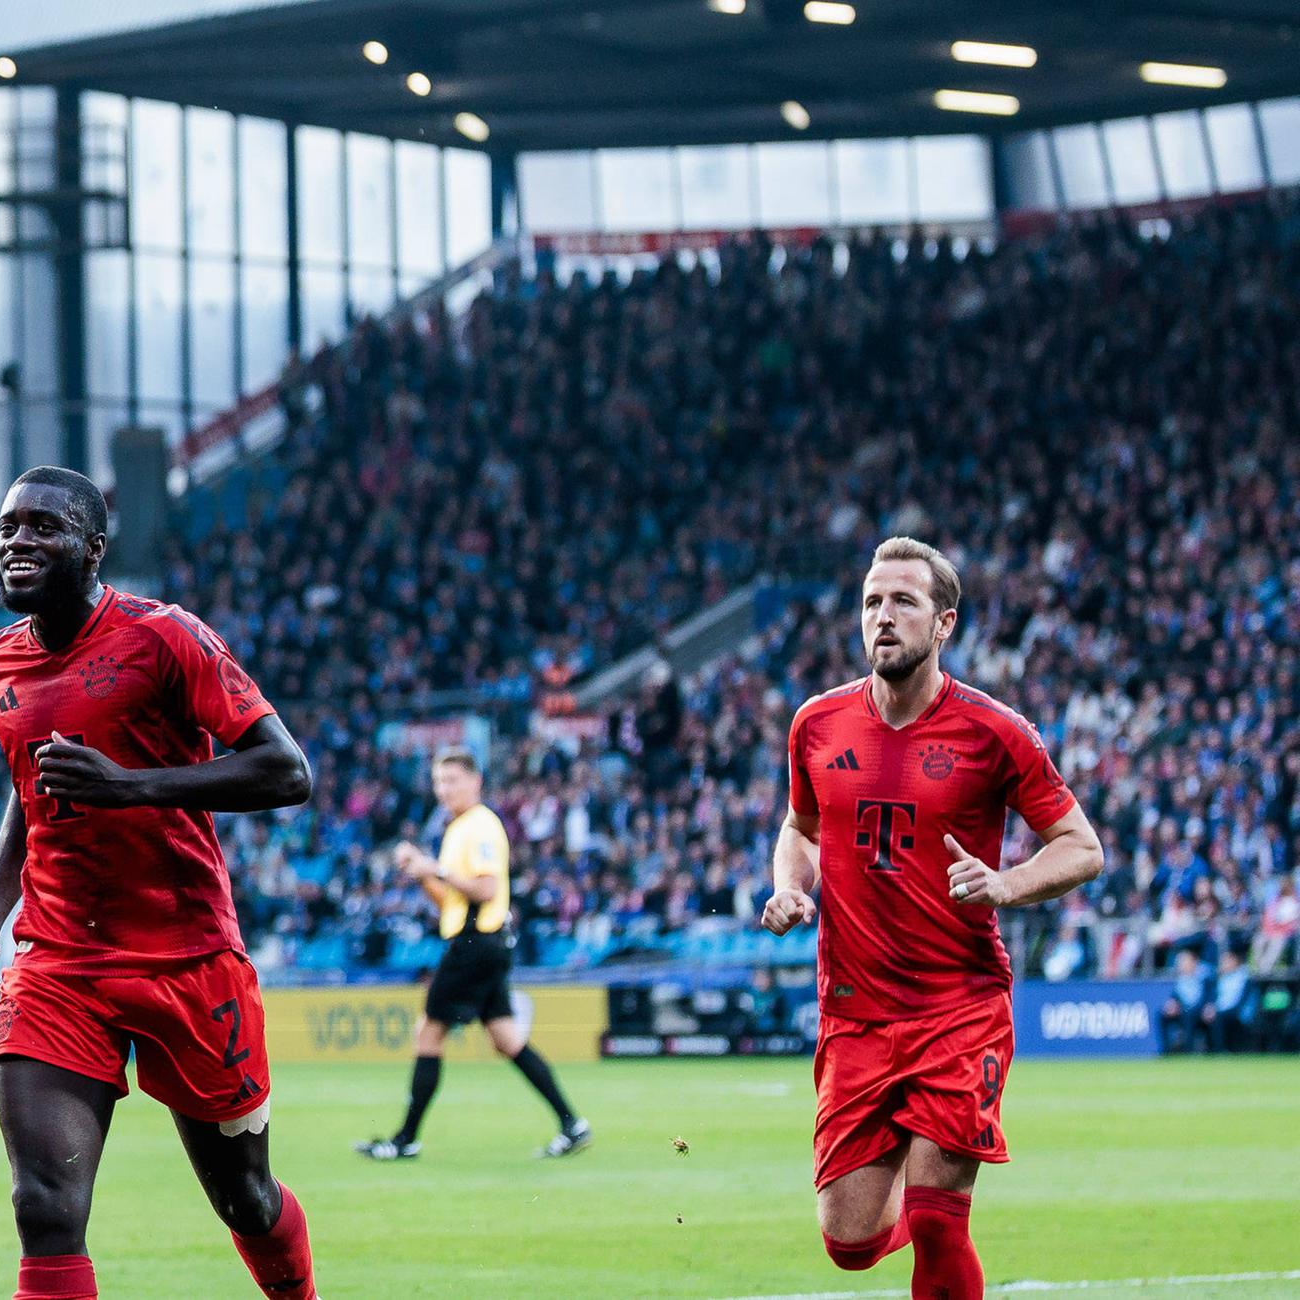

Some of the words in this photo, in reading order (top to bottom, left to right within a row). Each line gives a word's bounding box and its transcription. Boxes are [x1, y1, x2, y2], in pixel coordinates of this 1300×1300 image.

[857, 800, 916, 872] T
[211, 997, 250, 1069] 2
[981, 1055, 999, 1111] 9
